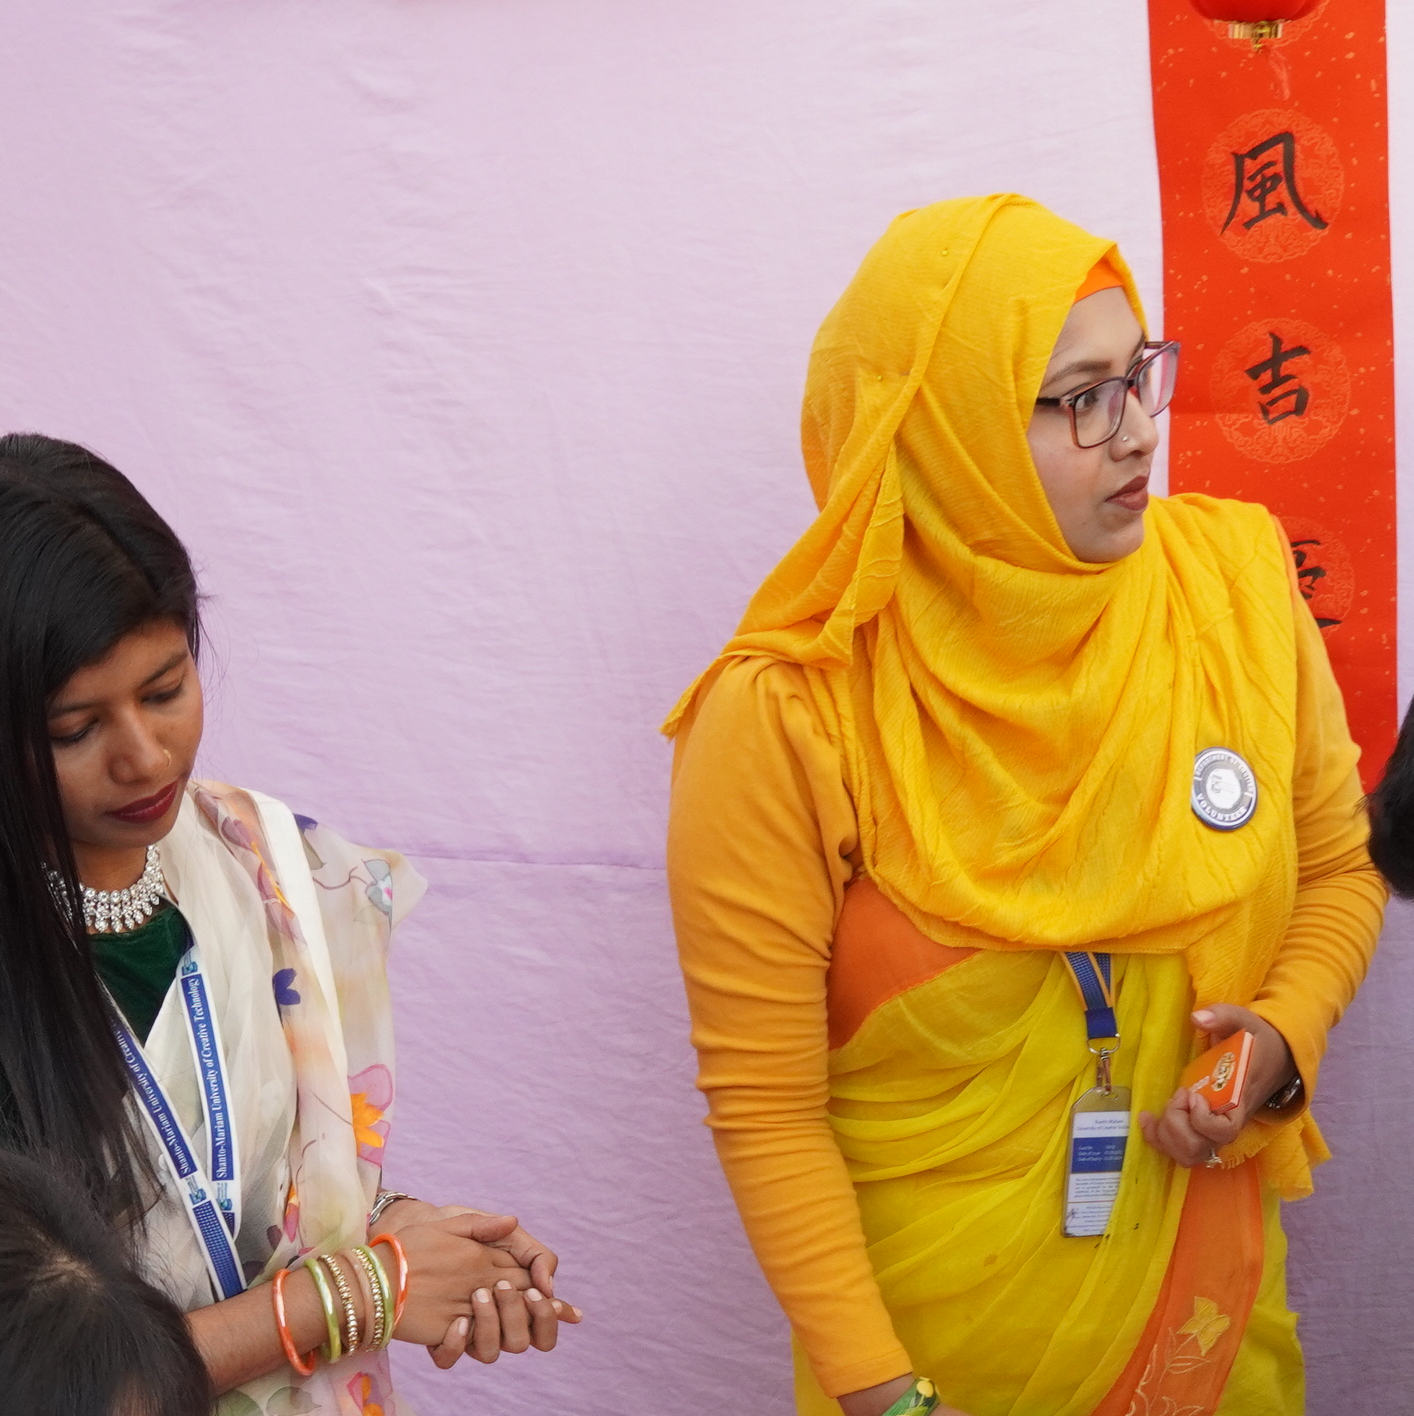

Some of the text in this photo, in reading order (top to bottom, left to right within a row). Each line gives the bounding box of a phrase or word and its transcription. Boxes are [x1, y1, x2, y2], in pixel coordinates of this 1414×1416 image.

[1197, 792, 1247, 821] VOLUNTEER
[187, 978, 206, 1022] Technology
[197, 1023, 213, 1058] Creative
[202, 1058, 215, 1068] of
[136, 1072, 163, 1114] University
[206, 1069, 223, 1111] University
[157, 1110, 192, 1175] Shanto-Mariam
[214, 1111, 228, 1179] Shanto-Mariam
